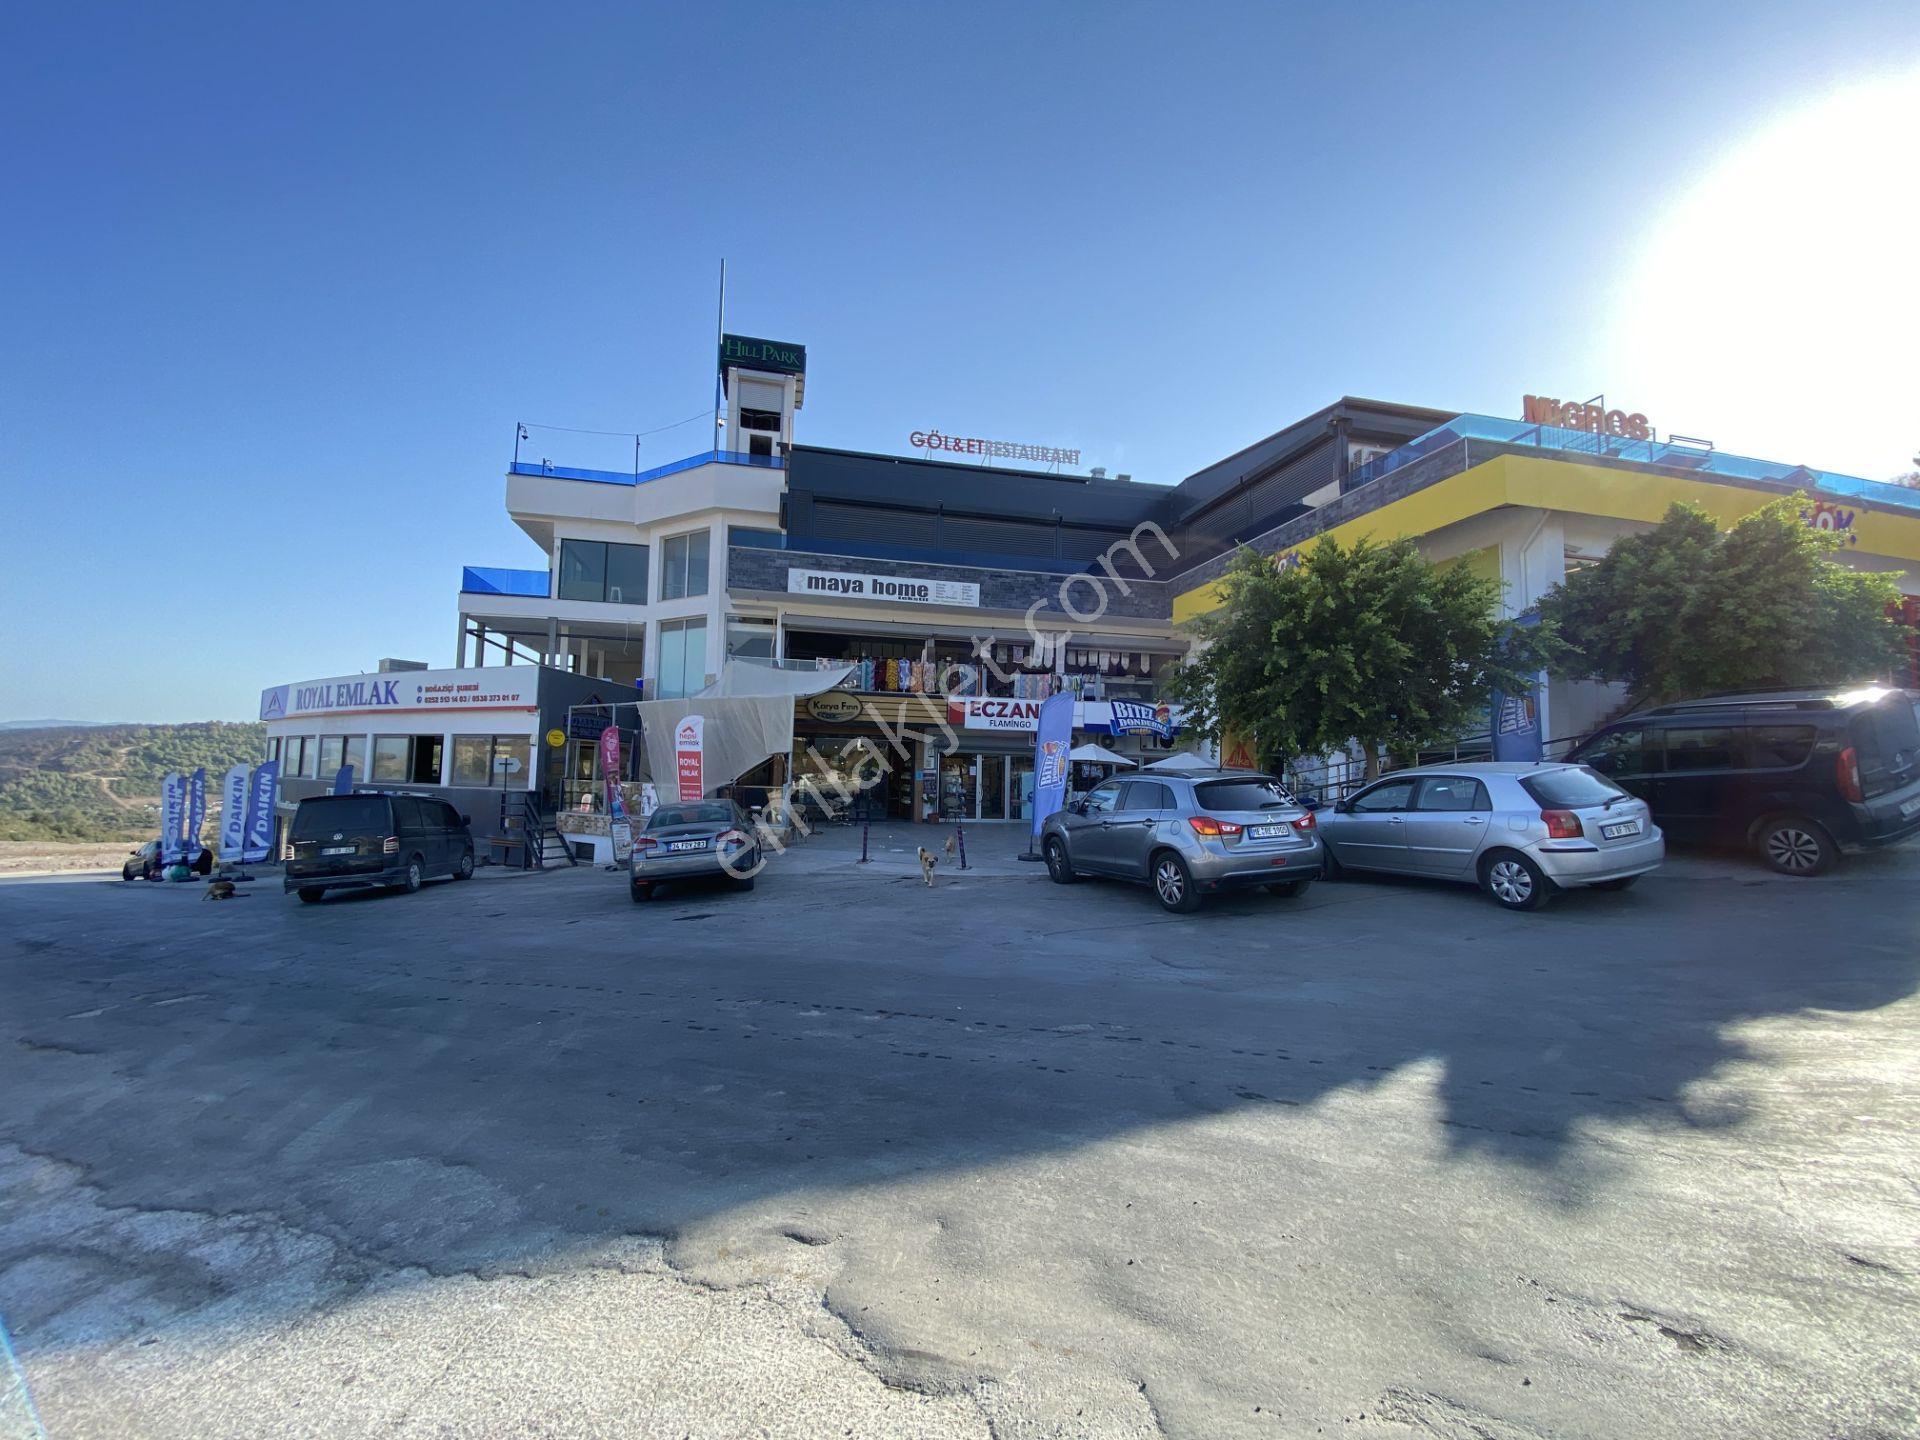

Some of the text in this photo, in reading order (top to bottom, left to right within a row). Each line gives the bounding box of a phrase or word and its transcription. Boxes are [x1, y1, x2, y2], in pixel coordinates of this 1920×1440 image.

[726, 340, 800, 366] HILL PARK
[910, 430, 1081, 466] GÖL&ET RESTAURANT
[807, 575, 864, 594] maya
[872, 578, 928, 598] home
[296, 680, 400, 711] ROYAL EMLAK
[970, 700, 1042, 719] ECZAN
[679, 758, 700, 767] ROYAL
[229, 776, 245, 834] DAIKIN
[256, 772, 273, 833] DAIKIN
